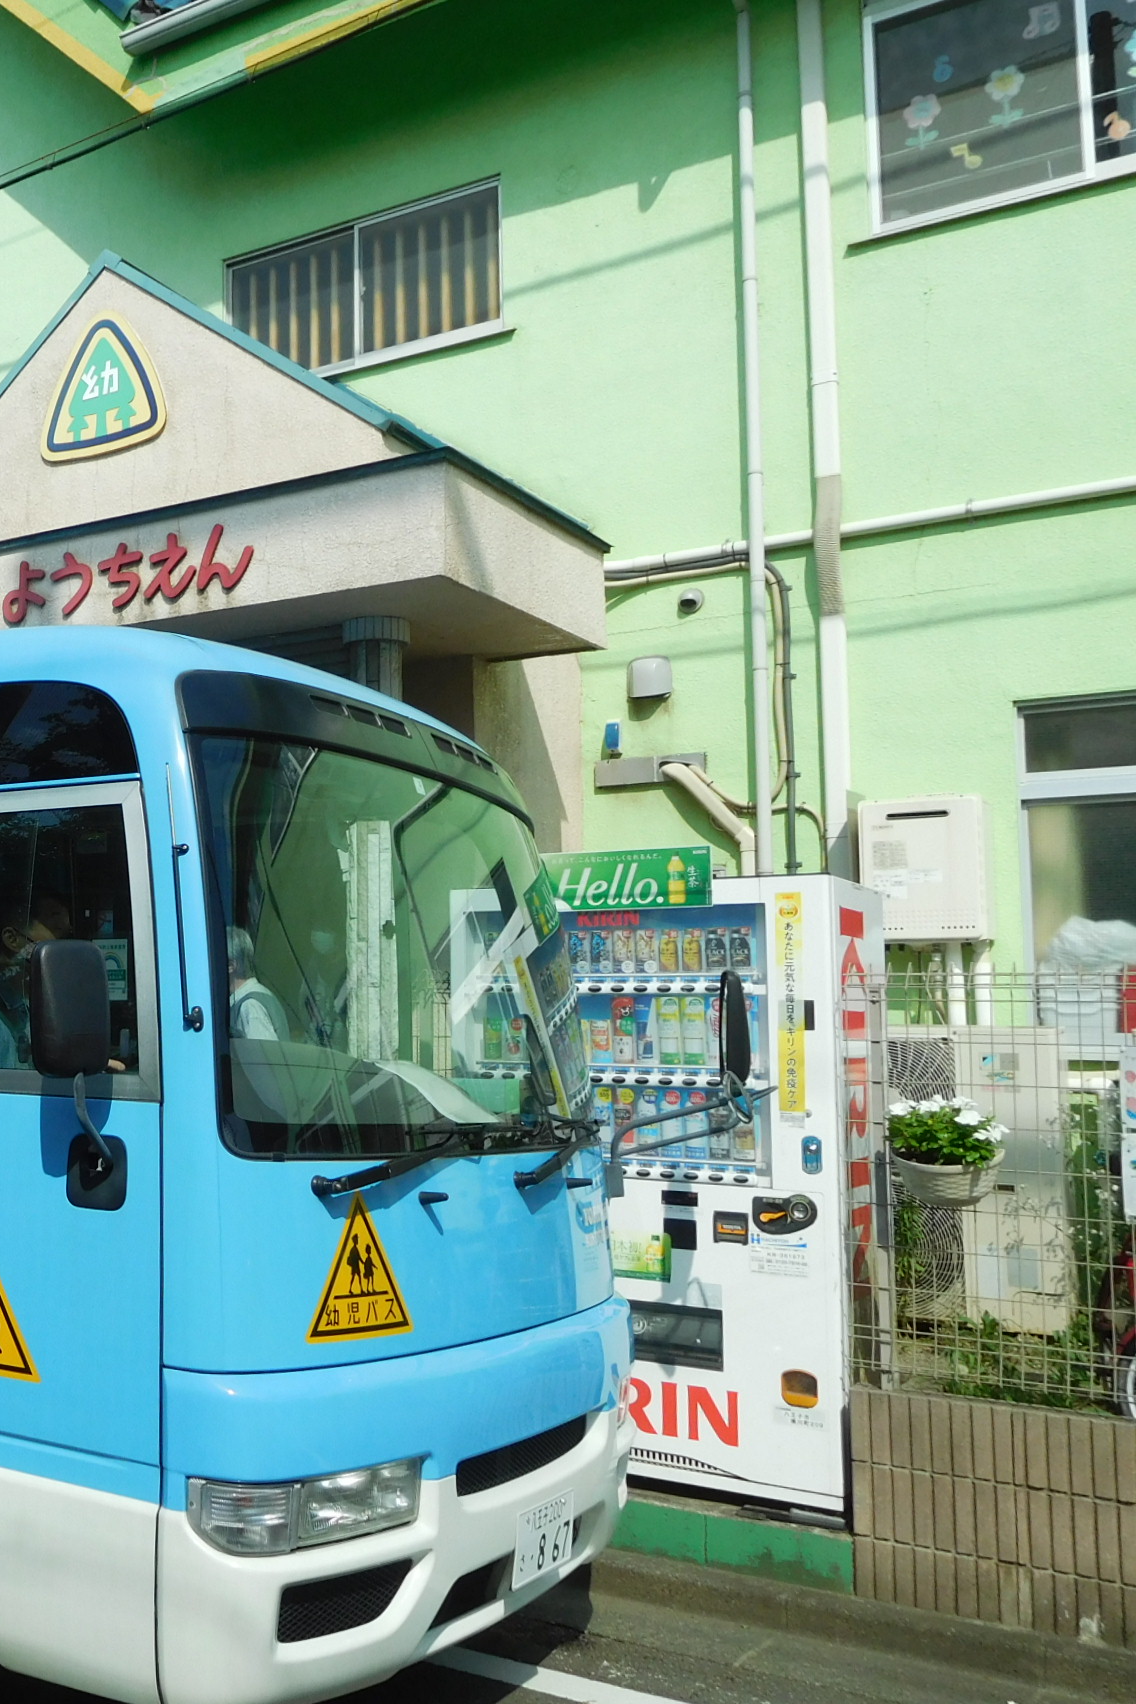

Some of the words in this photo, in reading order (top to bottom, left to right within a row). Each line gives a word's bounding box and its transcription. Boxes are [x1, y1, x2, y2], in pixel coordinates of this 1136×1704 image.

[81, 360, 119, 401] 幼
[557, 863, 665, 907] Hello.
[325, 1298, 397, 1327] 幼児バス
